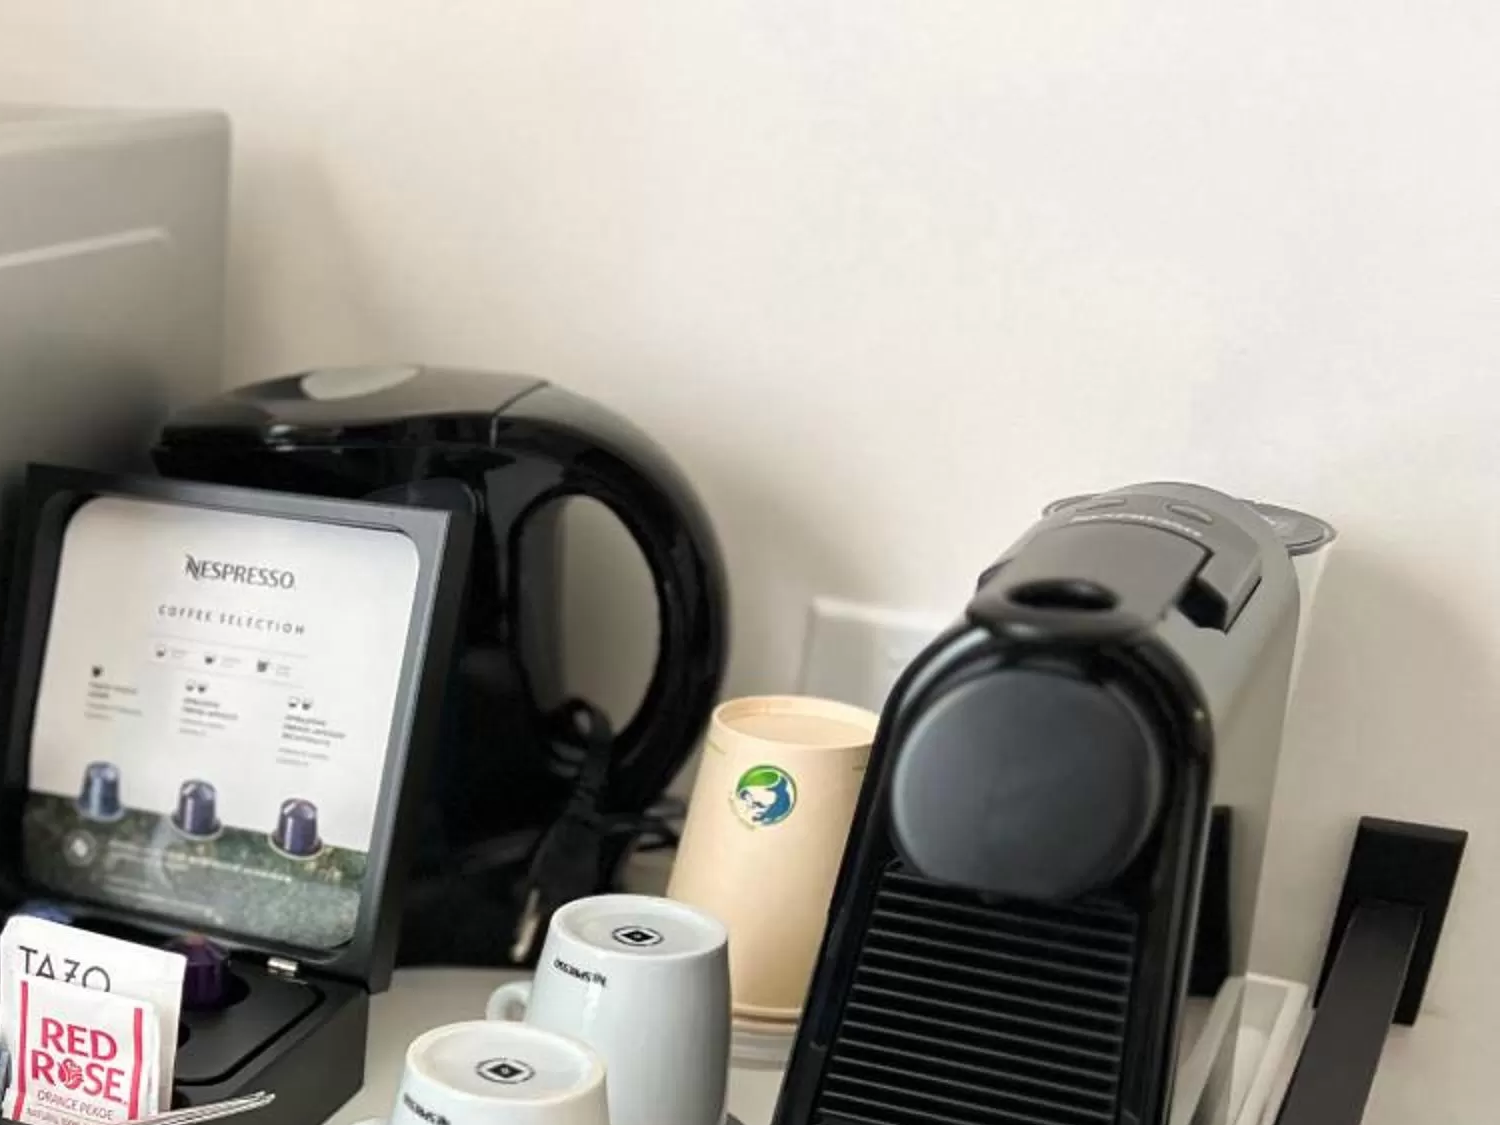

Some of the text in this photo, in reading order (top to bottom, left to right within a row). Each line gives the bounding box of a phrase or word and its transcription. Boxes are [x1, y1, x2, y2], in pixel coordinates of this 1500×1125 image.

[185, 554, 296, 589] NESPRESSO
[158, 604, 305, 635] COFFEE SELECTION
[41, 1017, 118, 1061] RED
